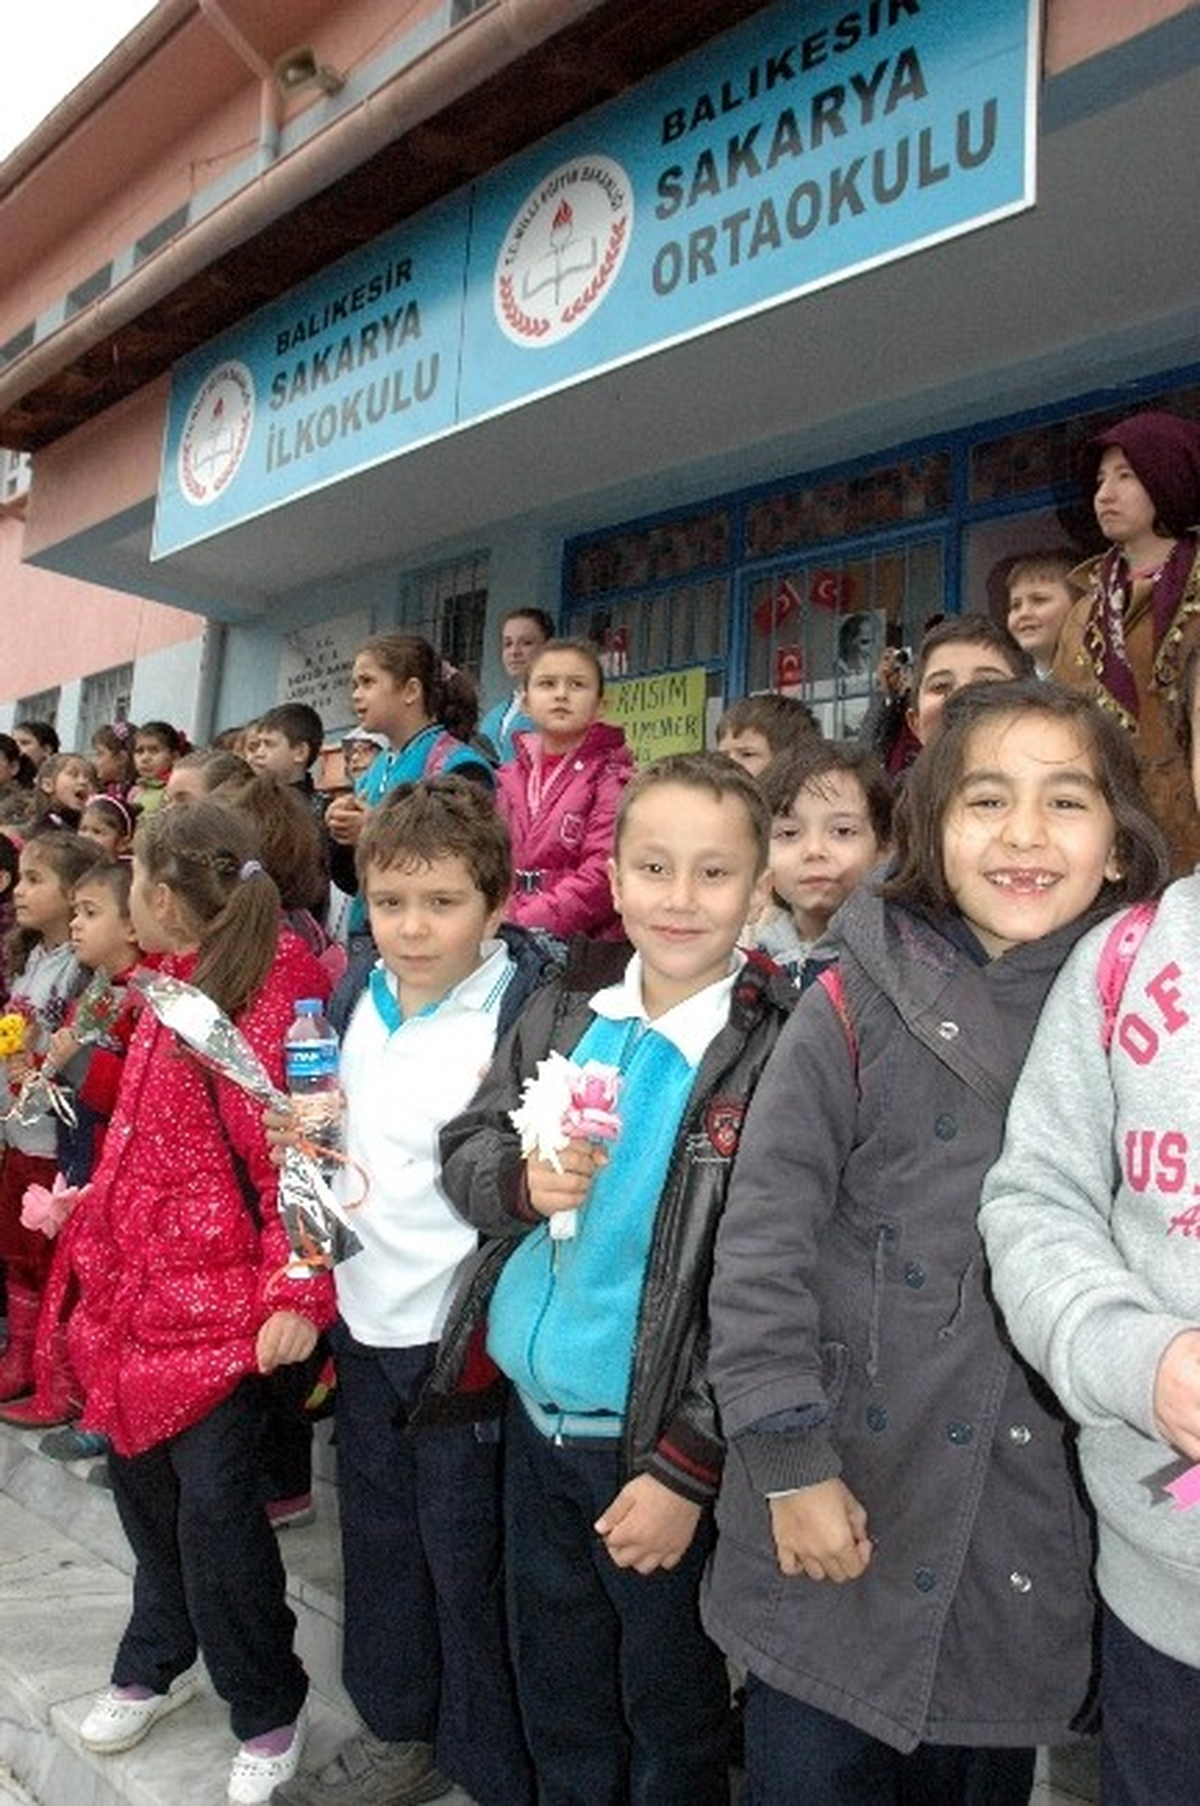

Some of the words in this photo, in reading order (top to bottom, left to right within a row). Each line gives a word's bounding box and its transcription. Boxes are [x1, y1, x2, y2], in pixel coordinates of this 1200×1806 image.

[655, 46, 928, 220] SAKARYA
[652, 98, 997, 296] ORTAOKULU
[269, 300, 423, 412] SAKARYA
[276, 257, 413, 356] BALIKESİR
[265, 352, 440, 474] İLKOKULU
[1119, 961, 1190, 1065] OF
[1124, 1130, 1200, 1196] US
